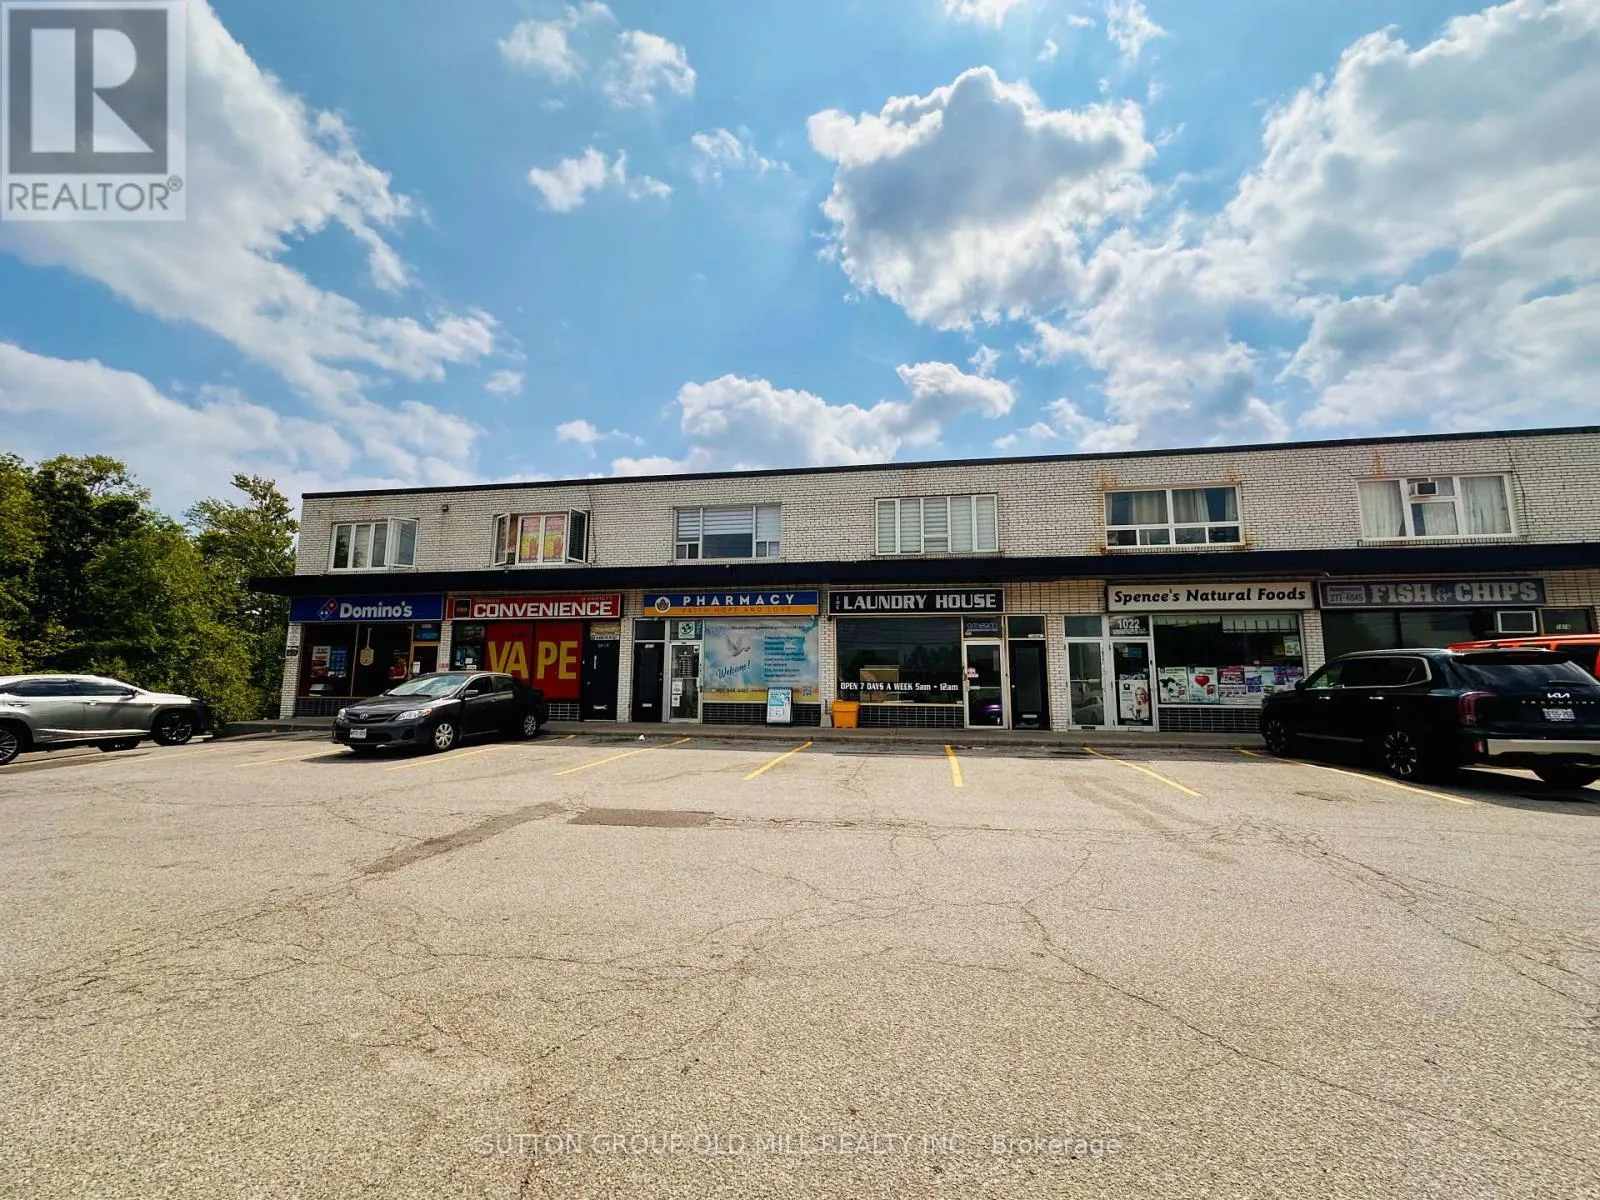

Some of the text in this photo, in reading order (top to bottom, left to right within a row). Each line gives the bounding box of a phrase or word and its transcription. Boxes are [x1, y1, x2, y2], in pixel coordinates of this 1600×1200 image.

[683, 594, 794, 606] PHARMACY
[1113, 587, 1306, 605] Spence's Natural Foods
[1369, 584, 1433, 602] FISH
[1433, 587, 1451, 603] &
[1454, 582, 1538, 602] CHIPS
[339, 601, 413, 618] Domino's
[473, 601, 613, 618] CONVENIENCE
[843, 593, 997, 610] LAUNDRY HOUSE
[1117, 619, 1140, 629] 1022
[488, 640, 578, 680] VAPE
[840, 682, 858, 690] OPEN
[867, 682, 884, 690] DAYS
[940, 682, 959, 691] 12am
